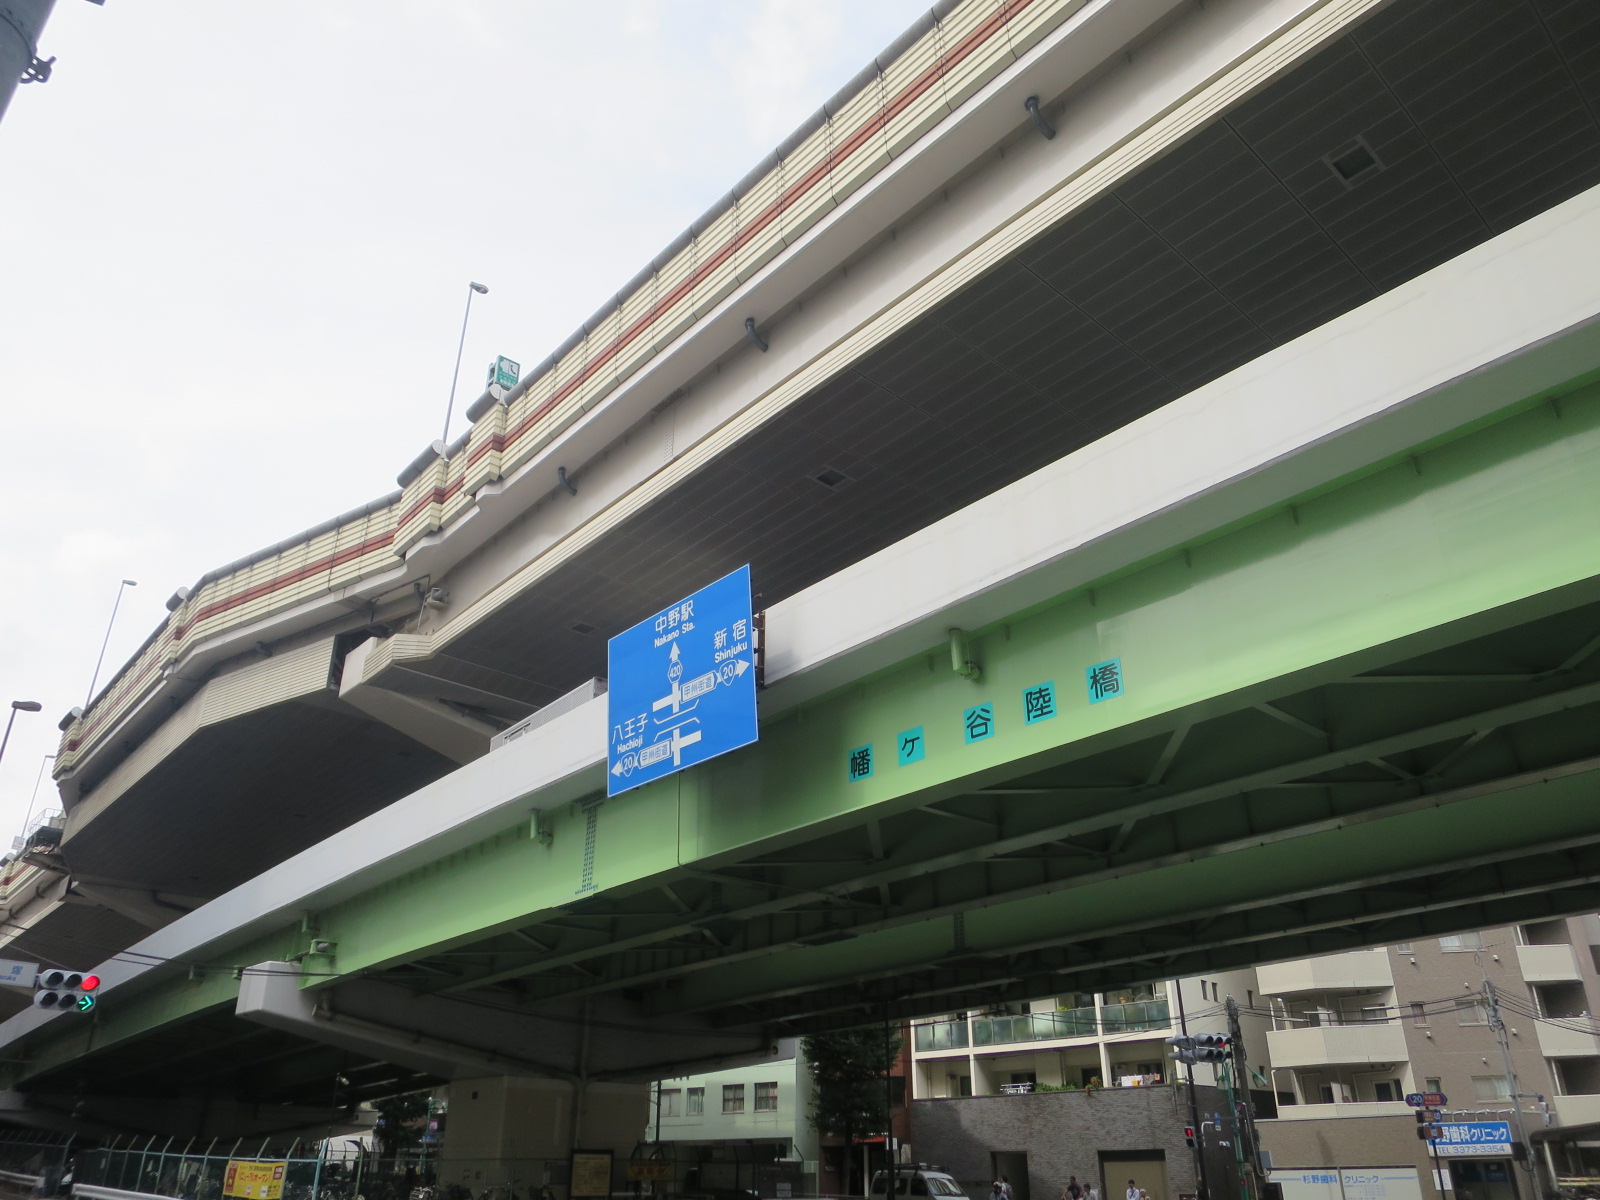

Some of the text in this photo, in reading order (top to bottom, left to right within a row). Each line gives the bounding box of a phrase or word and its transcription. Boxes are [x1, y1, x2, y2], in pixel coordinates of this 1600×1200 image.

[655, 600, 694, 634] 中野駅
[654, 622, 695, 648] Nakano Sta.
[713, 618, 747, 650] 新宿
[714, 640, 748, 664] Shinjuku
[669, 664, 681, 678] 420
[722, 663, 734, 678] 20
[683, 676, 714, 698] 甲州街道
[612, 712, 649, 744] 八王子
[617, 737, 643, 754] Hachioji
[641, 742, 669, 763] 甲州街道
[623, 757, 633, 770] 20
[1412, 1095, 1422, 1103] 20
[1434, 1125, 1507, 1143] 野歯科クリニック
[1438, 1145, 1505, 1154] TEL 3373-3354
[1344, 1175, 1379, 1184] クリニック
